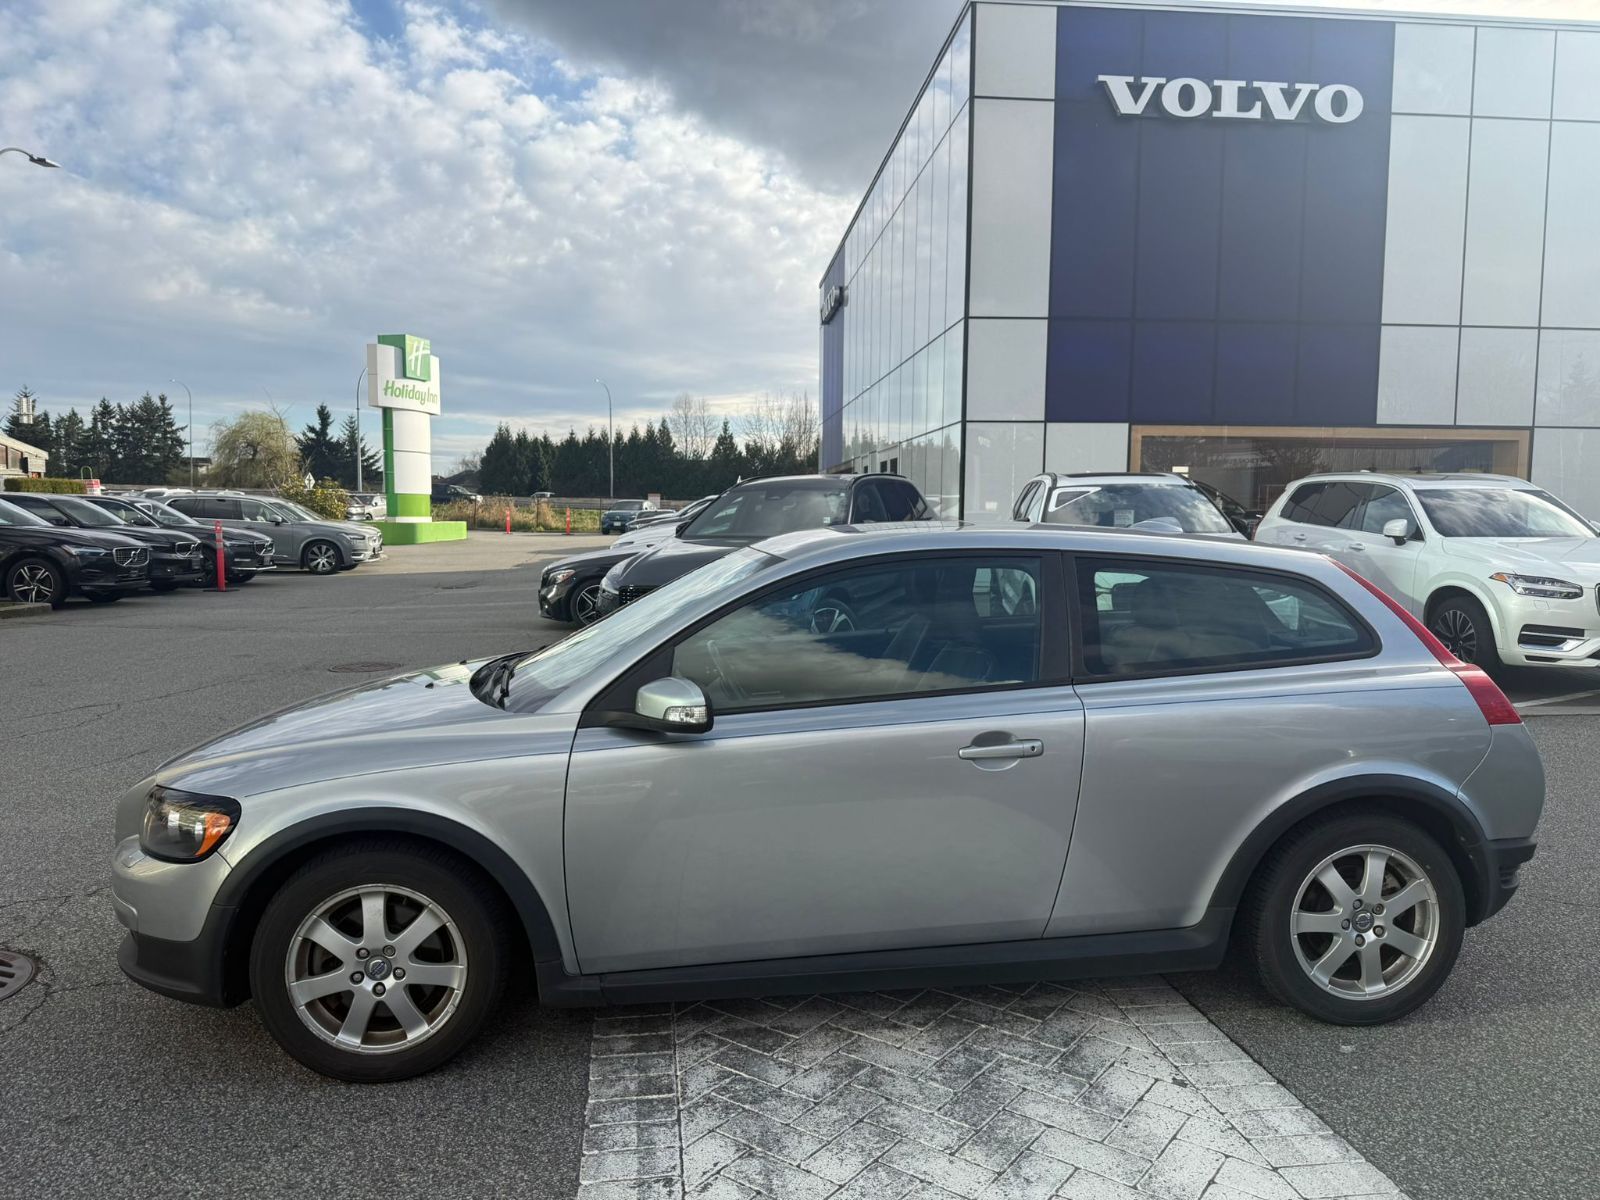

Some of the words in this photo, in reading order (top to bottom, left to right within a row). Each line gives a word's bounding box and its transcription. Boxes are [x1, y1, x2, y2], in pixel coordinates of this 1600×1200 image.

[1098, 75, 1364, 123] VOLVO
[383, 380, 426, 406] Holiday
[427, 387, 438, 404] Inn
